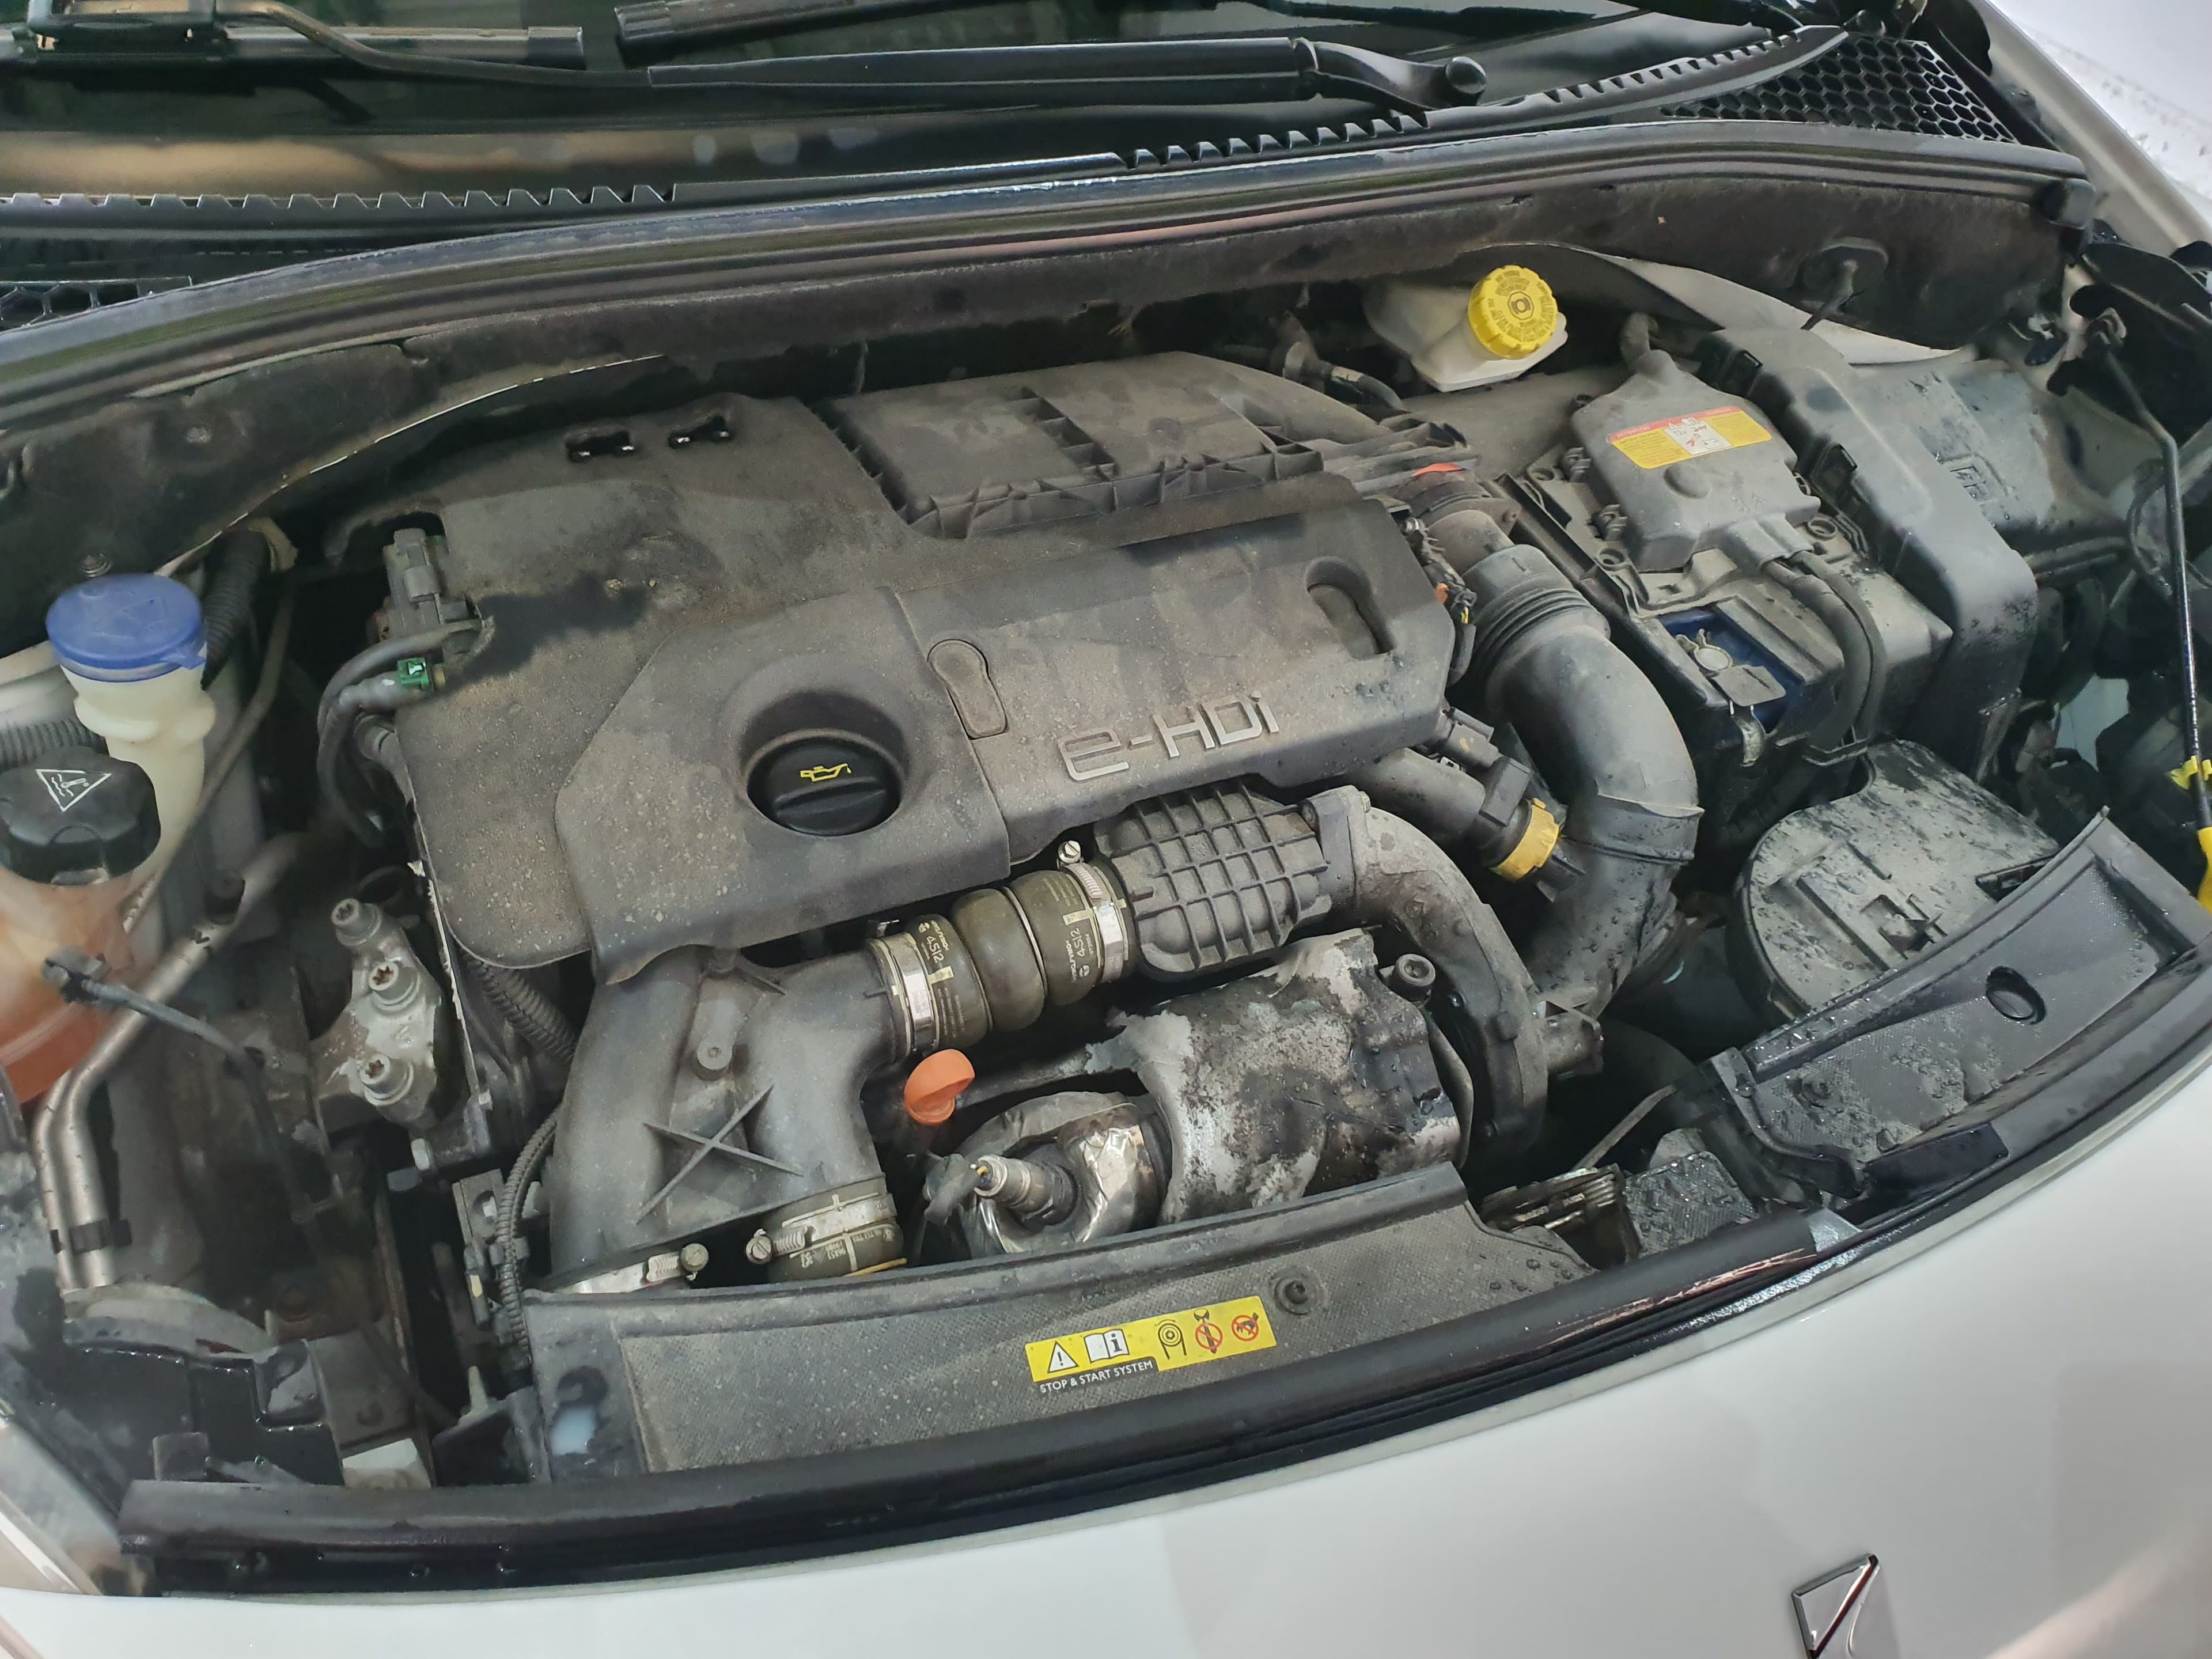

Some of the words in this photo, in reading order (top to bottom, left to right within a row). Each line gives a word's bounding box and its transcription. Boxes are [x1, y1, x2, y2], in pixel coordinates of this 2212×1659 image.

[1058, 691, 1279, 782] e-HDi
[1040, 1379, 1067, 1393] STOP
[1070, 1377, 1078, 1387] &
[1079, 1369, 1111, 1384] START
[1113, 1360, 1153, 1377] SYSTEM
